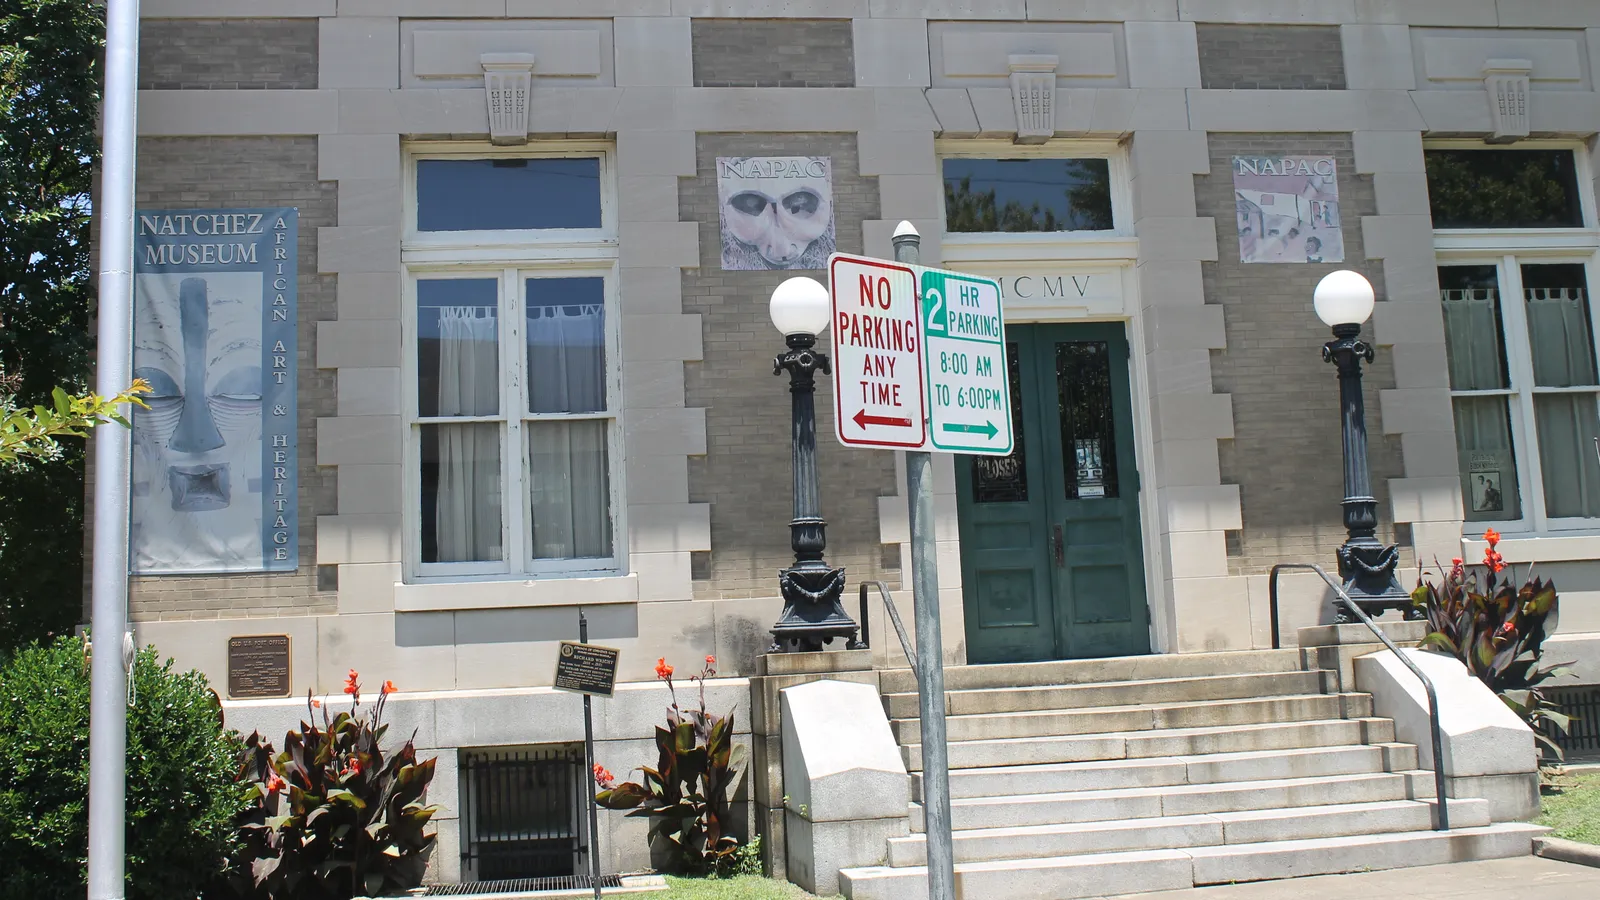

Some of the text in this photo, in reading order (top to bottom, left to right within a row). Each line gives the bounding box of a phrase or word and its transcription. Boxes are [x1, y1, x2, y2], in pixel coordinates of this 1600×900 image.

[721, 160, 826, 179] NAPAC
[1238, 159, 1332, 177] NAPAC
[139, 213, 264, 236] NATCHEZ
[145, 243, 258, 265] MUSEUM
[859, 273, 891, 310] NO
[960, 285, 980, 308] HR
[925, 287, 944, 331] 2
[839, 311, 915, 353] PARKING
[949, 311, 999, 338] PARKING
[863, 353, 896, 379] ANY
[940, 351, 992, 378] 8:00 AM
[272, 217, 288, 560] AFRICAN ART & HERITAGE
[859, 381, 902, 407] TIME
[935, 384, 1001, 411] TO 6:00PM
